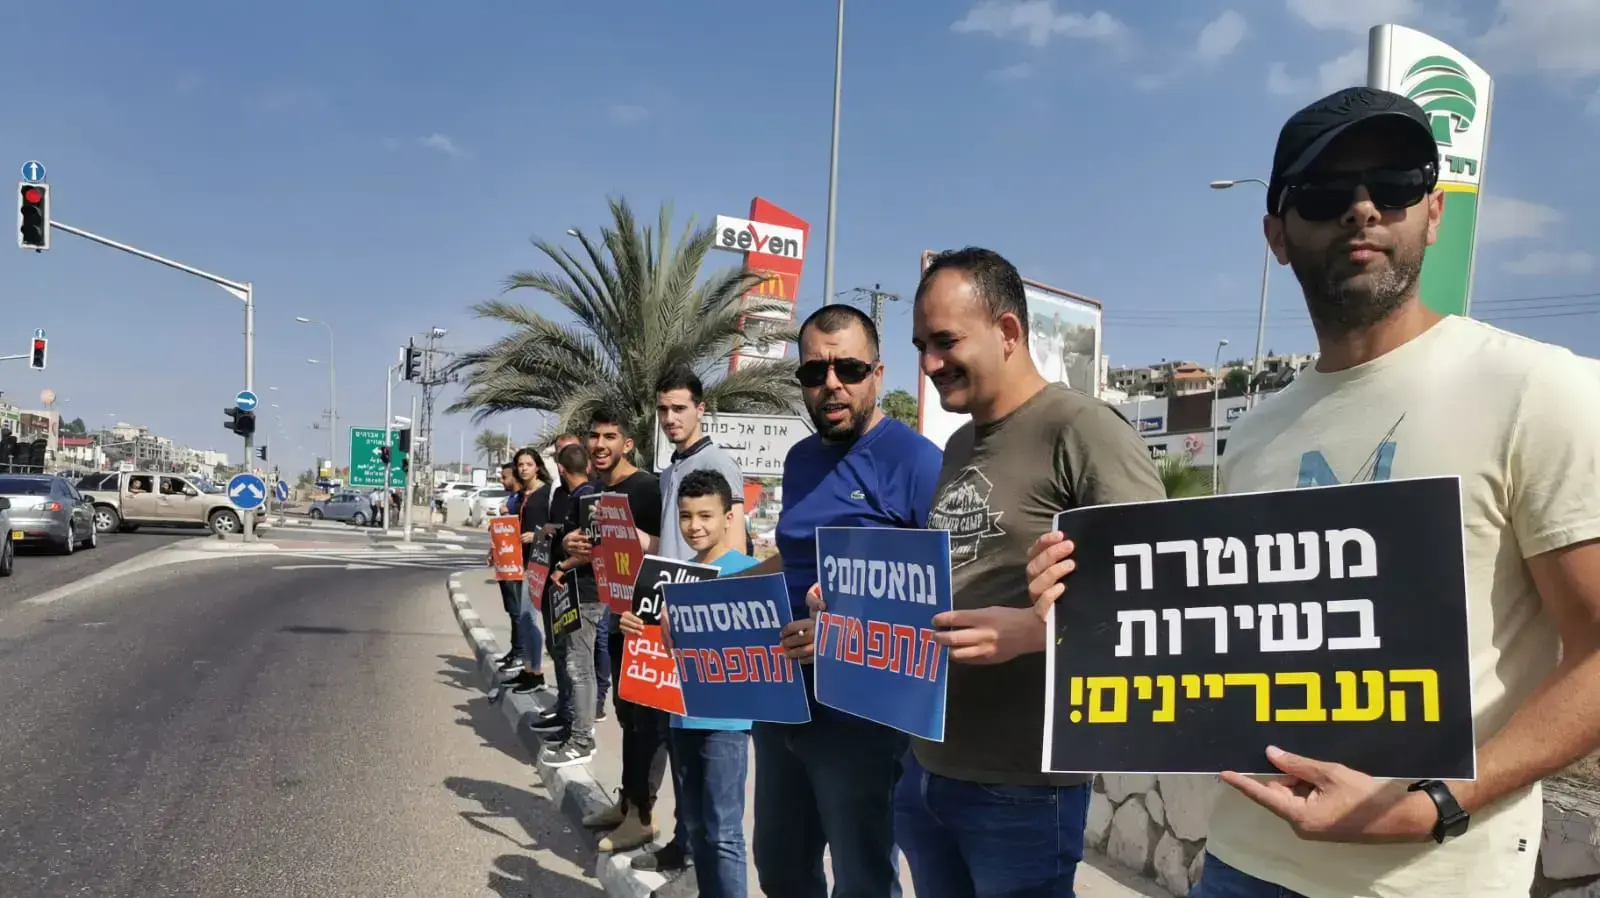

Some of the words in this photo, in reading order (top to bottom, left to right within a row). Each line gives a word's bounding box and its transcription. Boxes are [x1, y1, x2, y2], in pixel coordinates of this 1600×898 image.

[701, 422, 756, 435] אל-פחם
[764, 425, 788, 437] אום
[736, 457, 784, 469] Al-Fah
[960, 512, 983, 533] CAMP
[1113, 528, 1378, 592] משטרה
[823, 555, 938, 606] נמאסתם?
[671, 599, 781, 633] נמאסתם?
[1114, 598, 1382, 657] בשירות
[671, 645, 794, 683] תתפטרו
[817, 611, 942, 682] תתפטרו
[1069, 669, 1440, 724] העבריינים!
